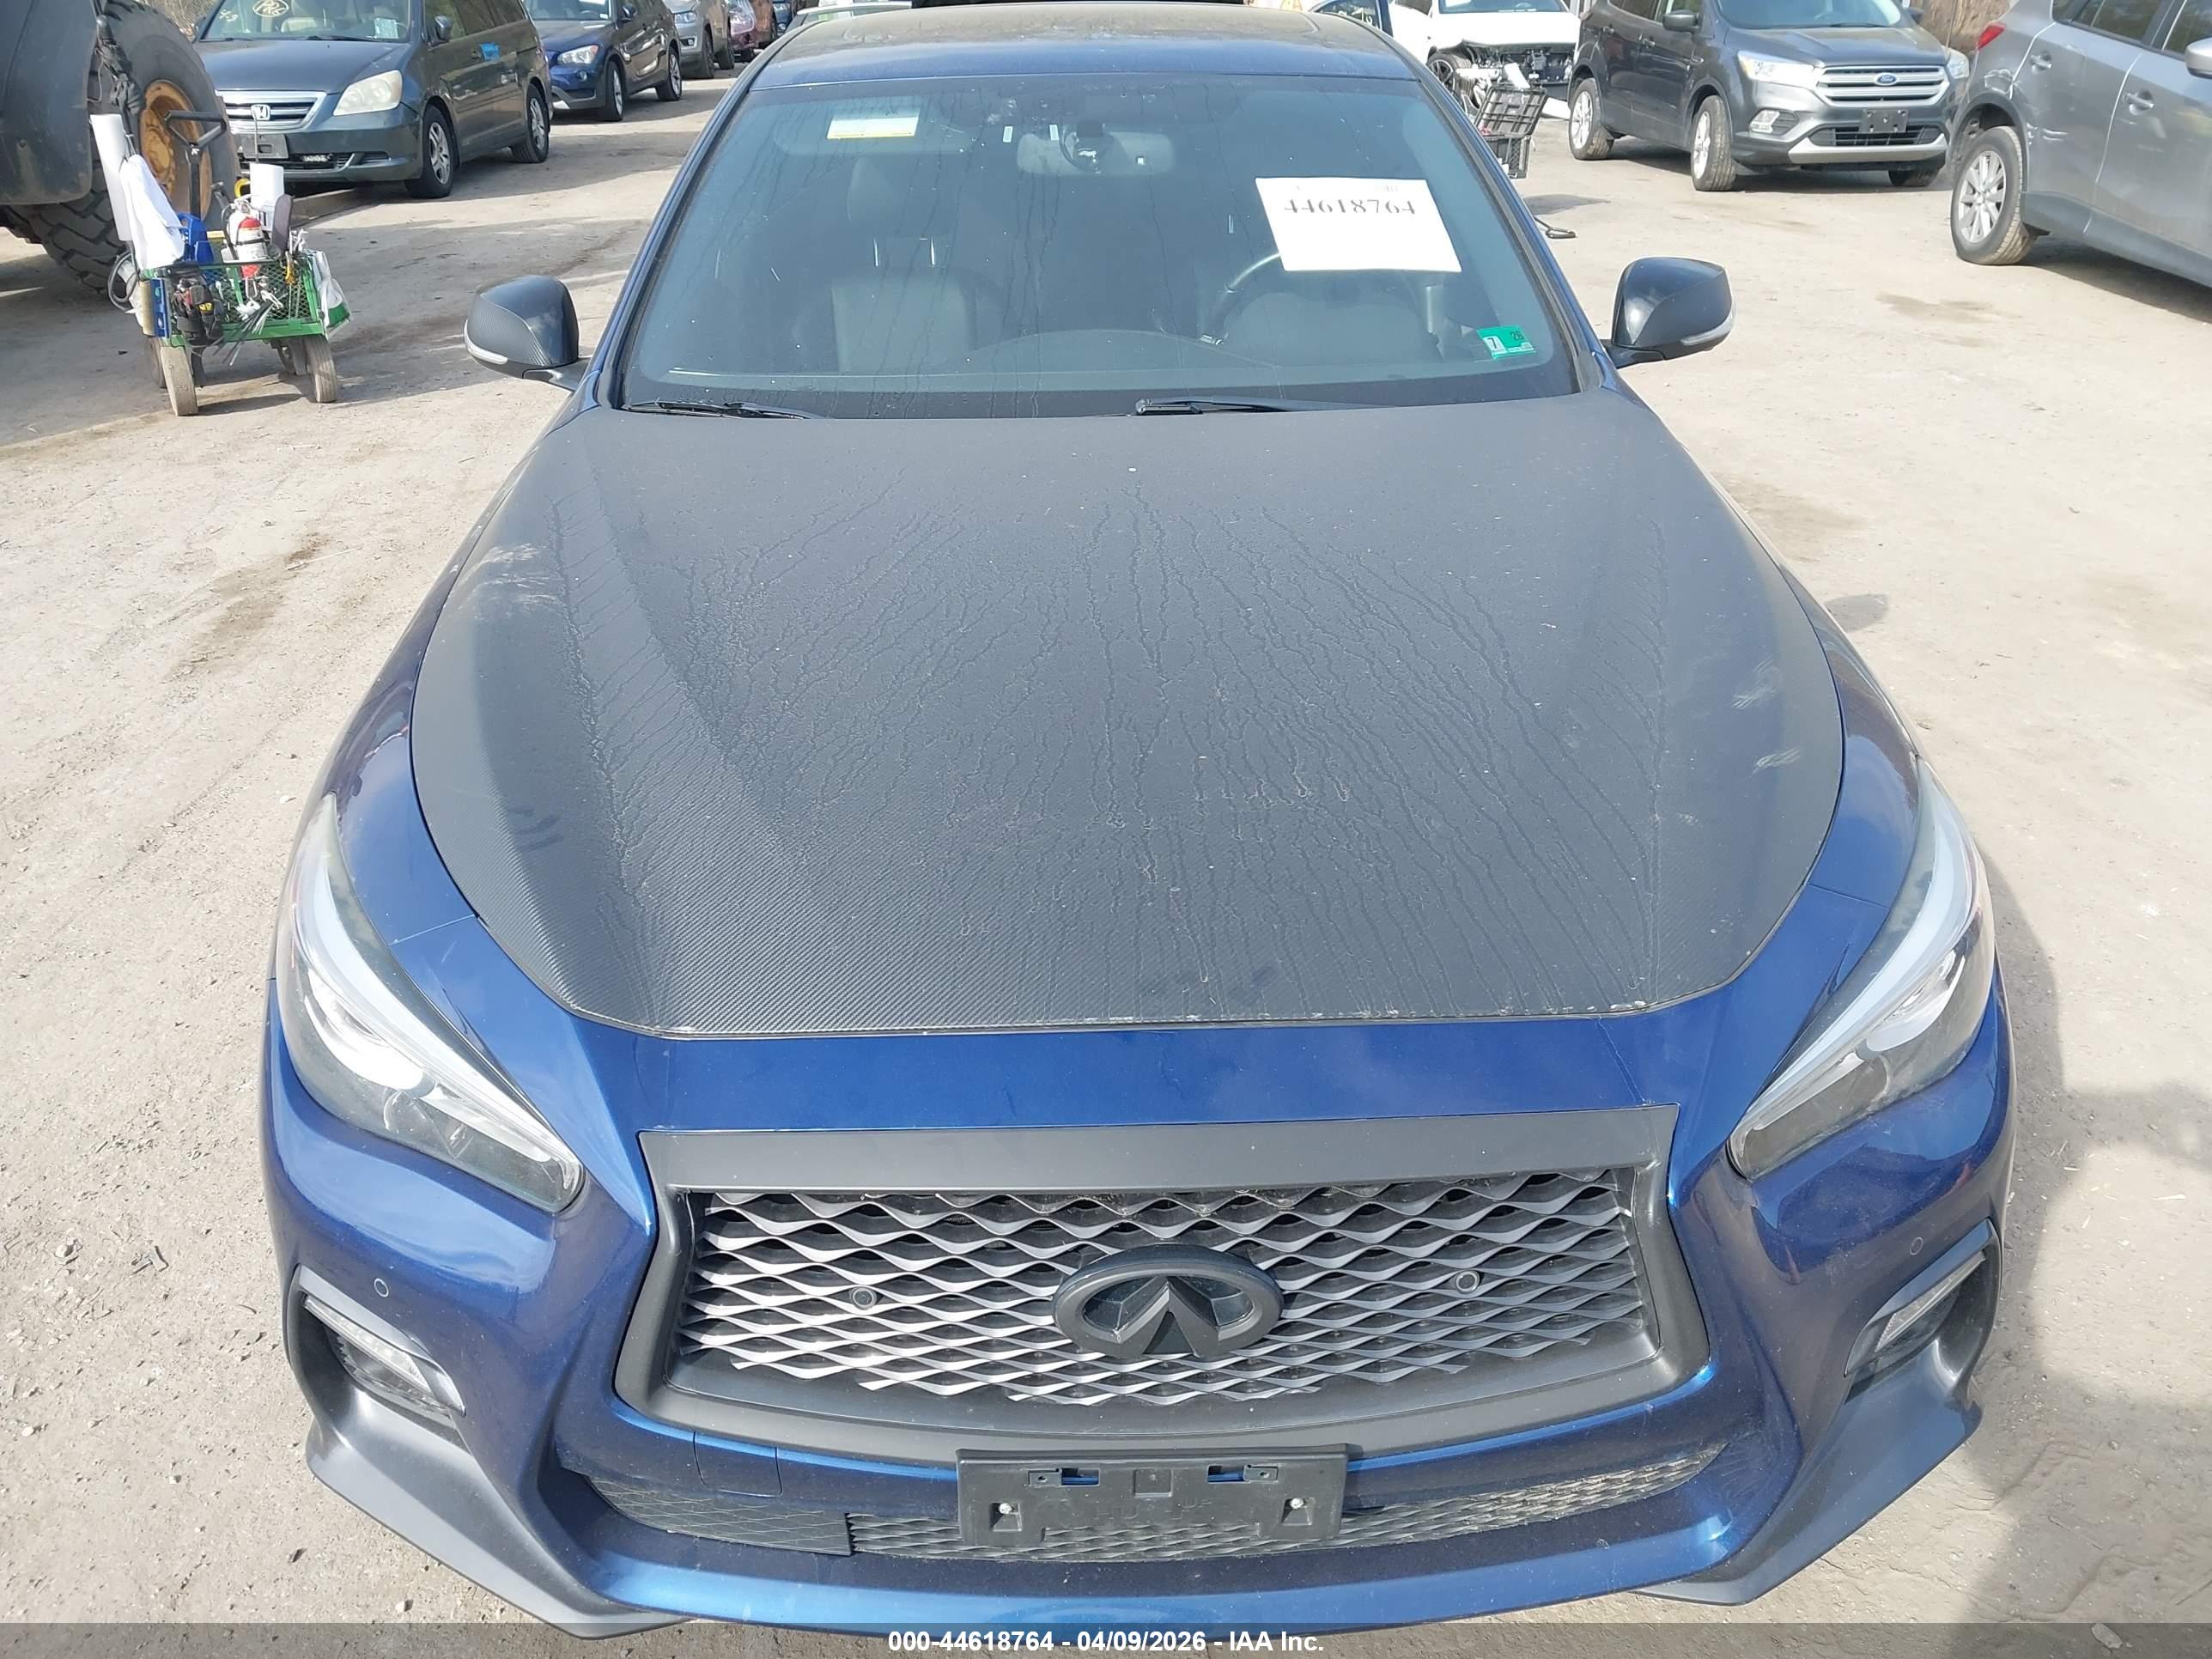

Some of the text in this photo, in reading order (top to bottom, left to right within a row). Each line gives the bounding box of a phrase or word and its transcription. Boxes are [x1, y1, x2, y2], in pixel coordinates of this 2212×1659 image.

[1285, 198, 1416, 215] 44618764
[1510, 331, 1525, 341] 26
[1487, 337, 1498, 349] 7
